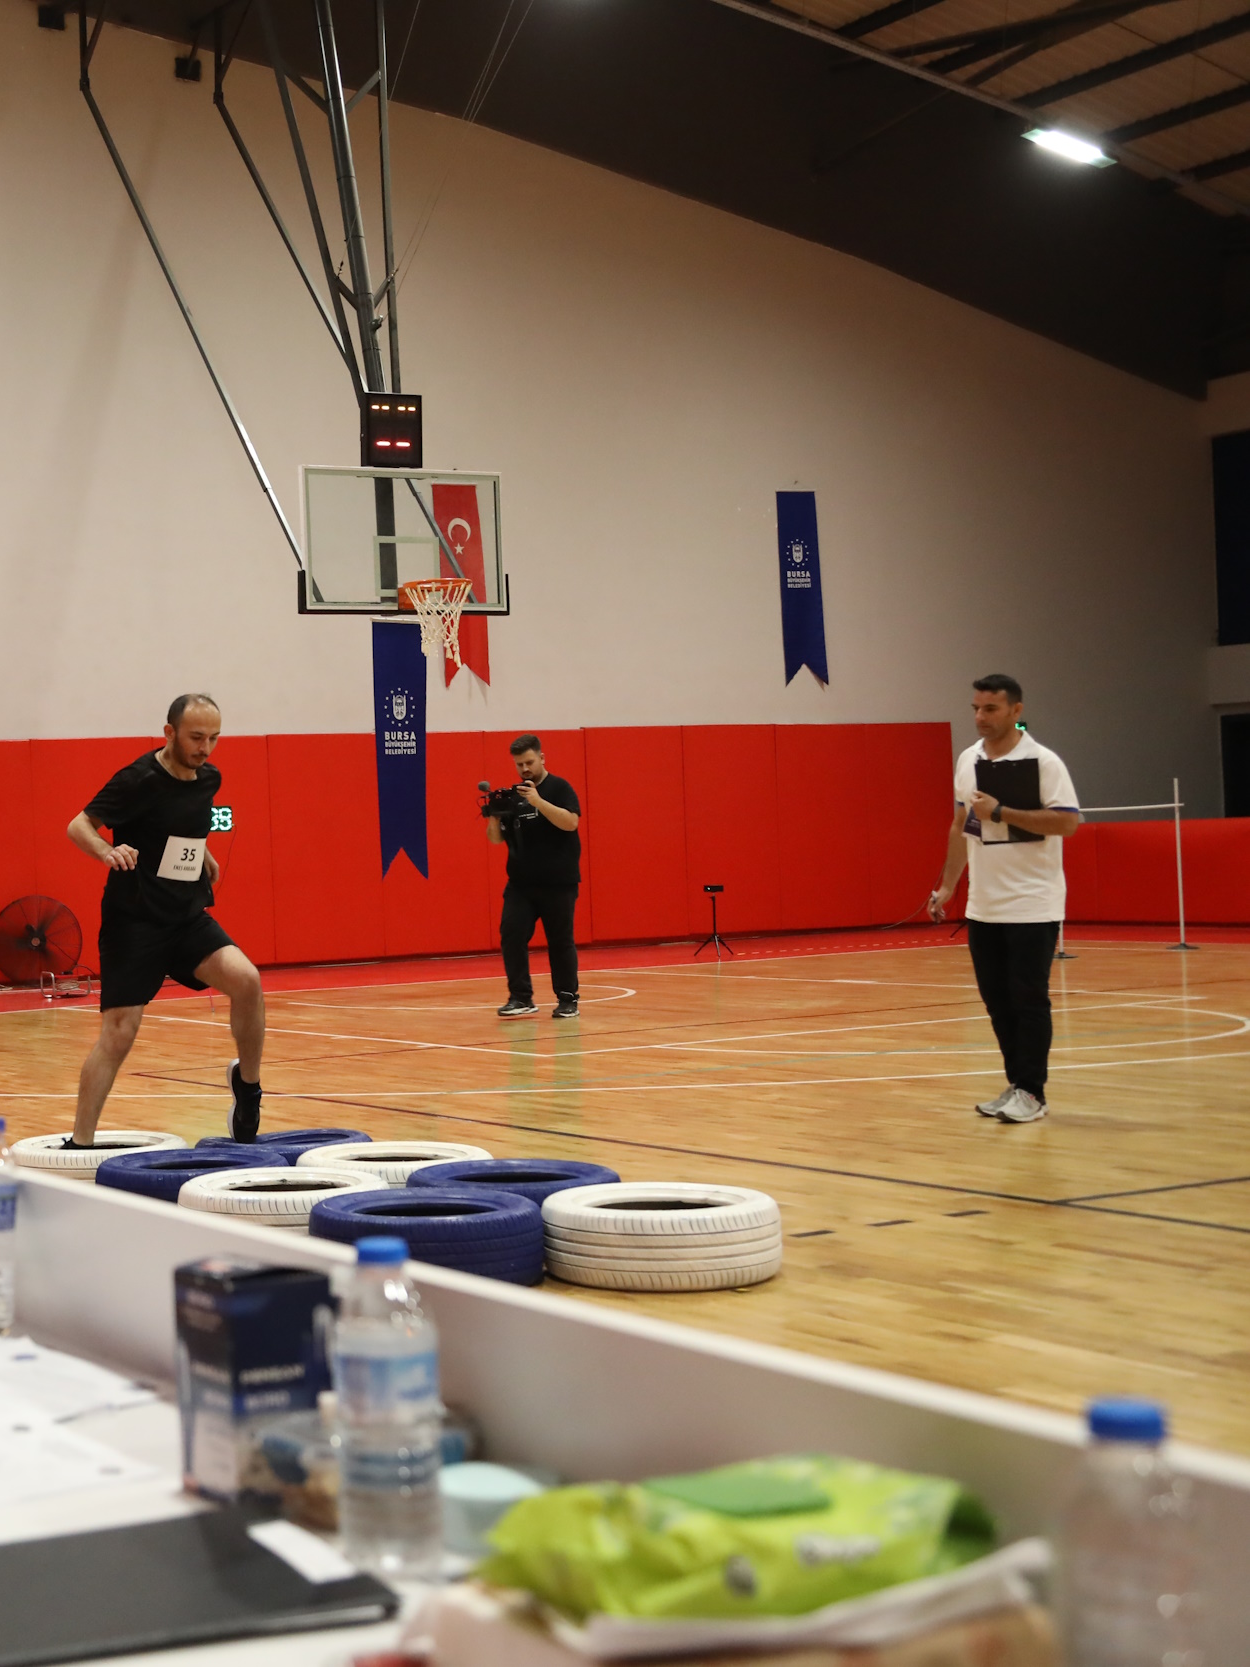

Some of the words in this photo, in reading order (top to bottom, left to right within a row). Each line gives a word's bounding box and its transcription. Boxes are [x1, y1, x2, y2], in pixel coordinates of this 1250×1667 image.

[384, 731, 416, 740] BURSA
[385, 747, 417, 755] BELEDİYESİ
[180, 848, 196, 862] 35
